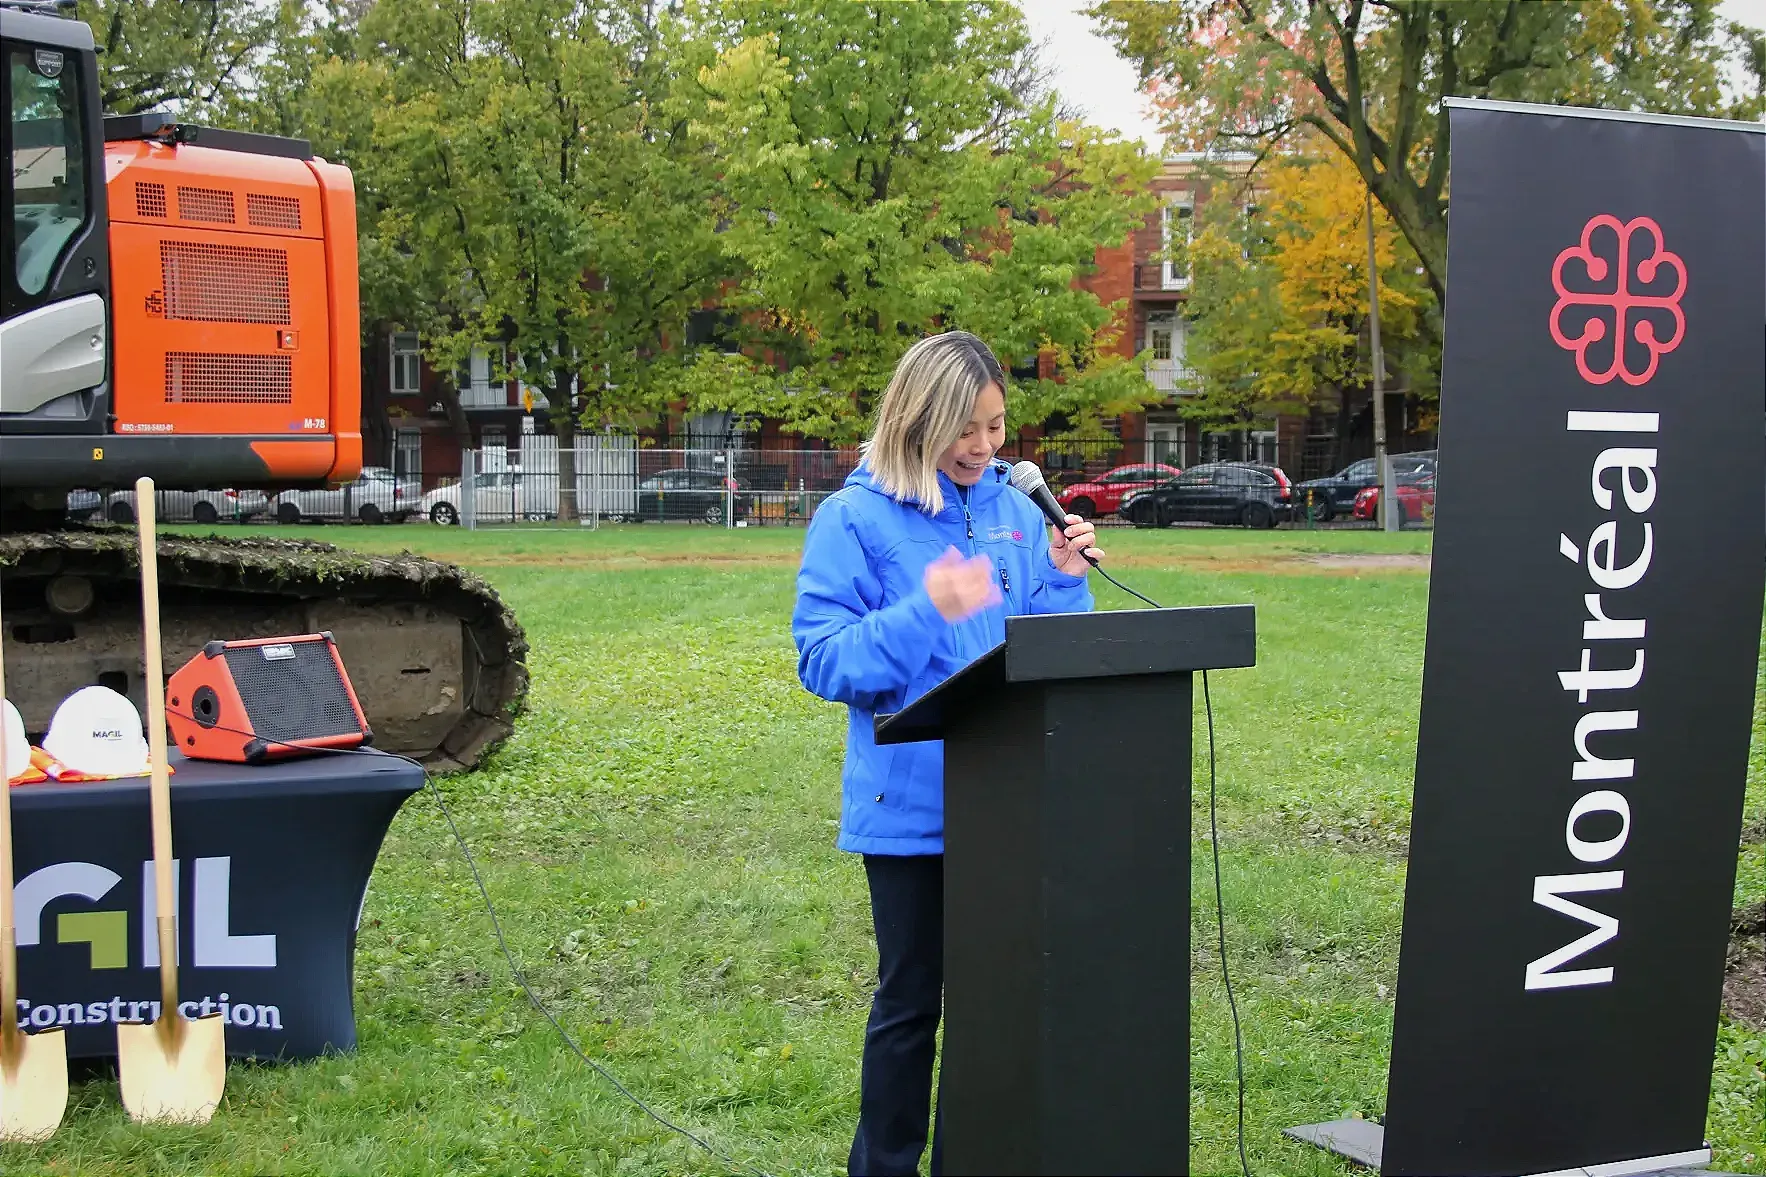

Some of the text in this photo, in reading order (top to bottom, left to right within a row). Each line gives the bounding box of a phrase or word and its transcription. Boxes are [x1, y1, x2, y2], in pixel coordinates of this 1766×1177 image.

[304, 418, 326, 429] M-78
[1524, 410, 1660, 992] Montréal
[92, 730, 123, 739] MAGIL
